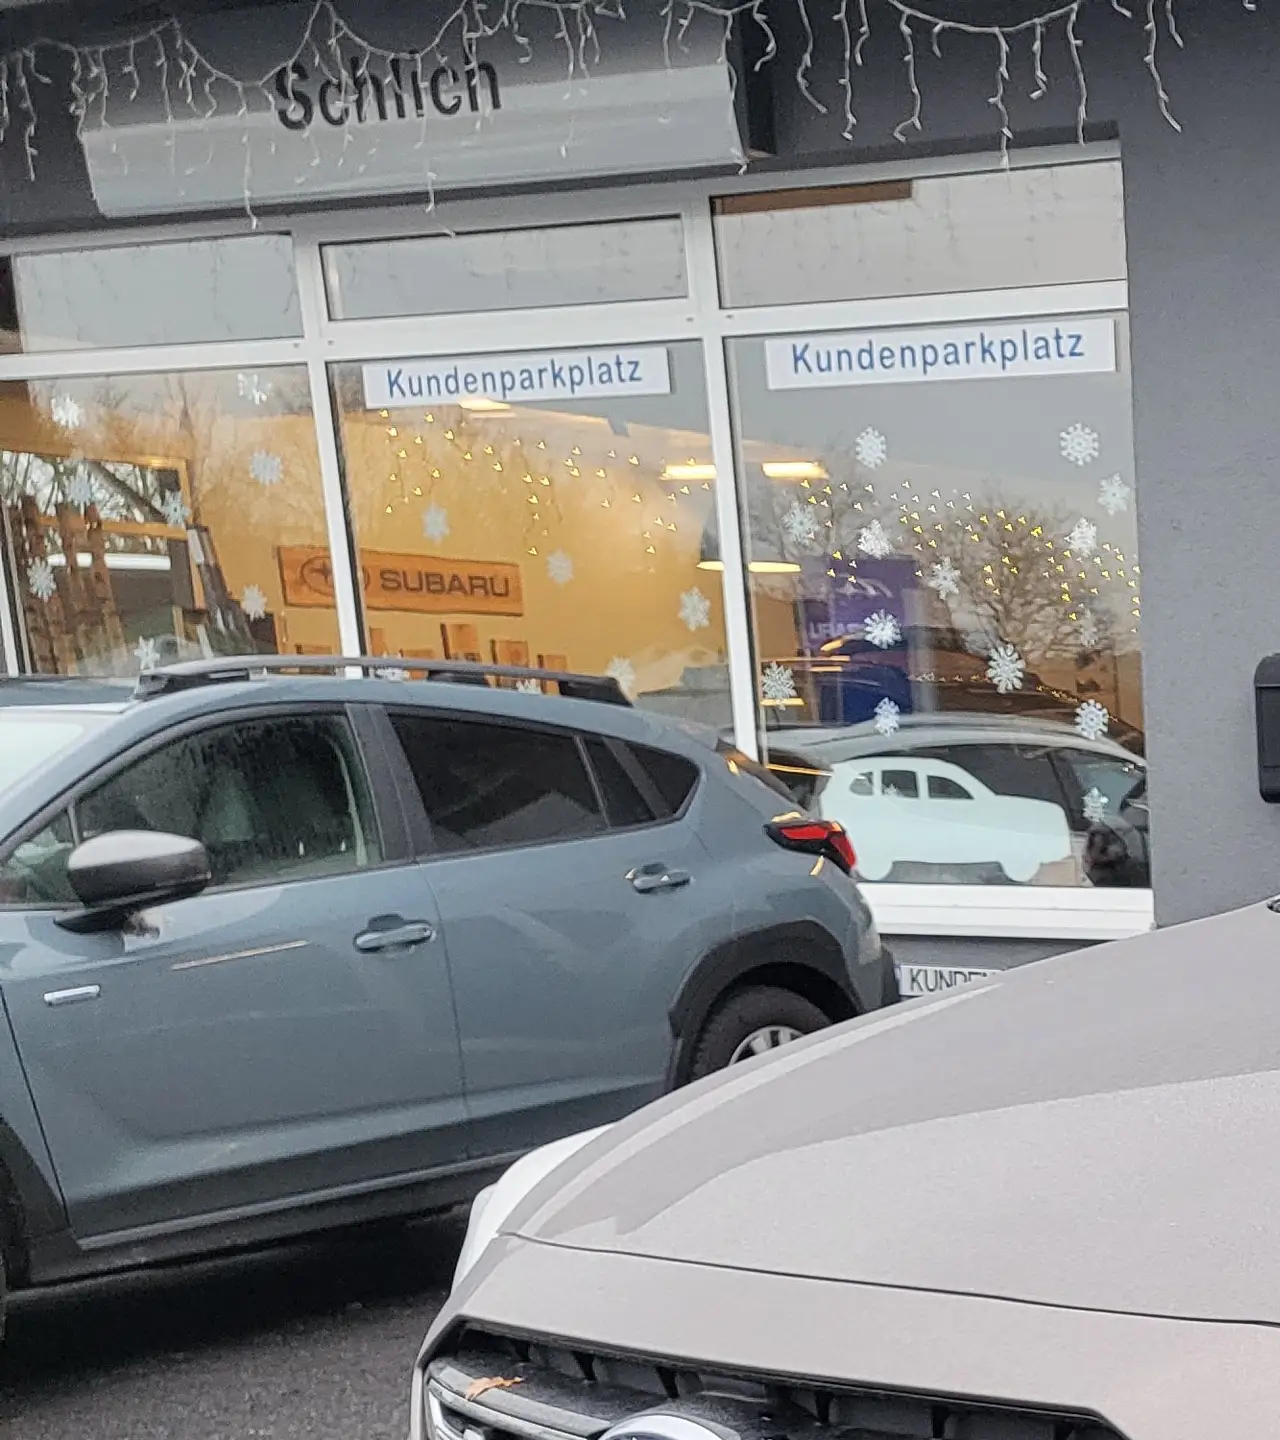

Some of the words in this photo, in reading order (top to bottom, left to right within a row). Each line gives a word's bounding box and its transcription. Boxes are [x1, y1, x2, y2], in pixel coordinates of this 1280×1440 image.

[275, 41, 501, 131] Schlich
[791, 326, 1085, 376] Kundenparkplatz
[386, 354, 643, 400] Kundenparkplatz
[379, 568, 510, 598] SUBARU
